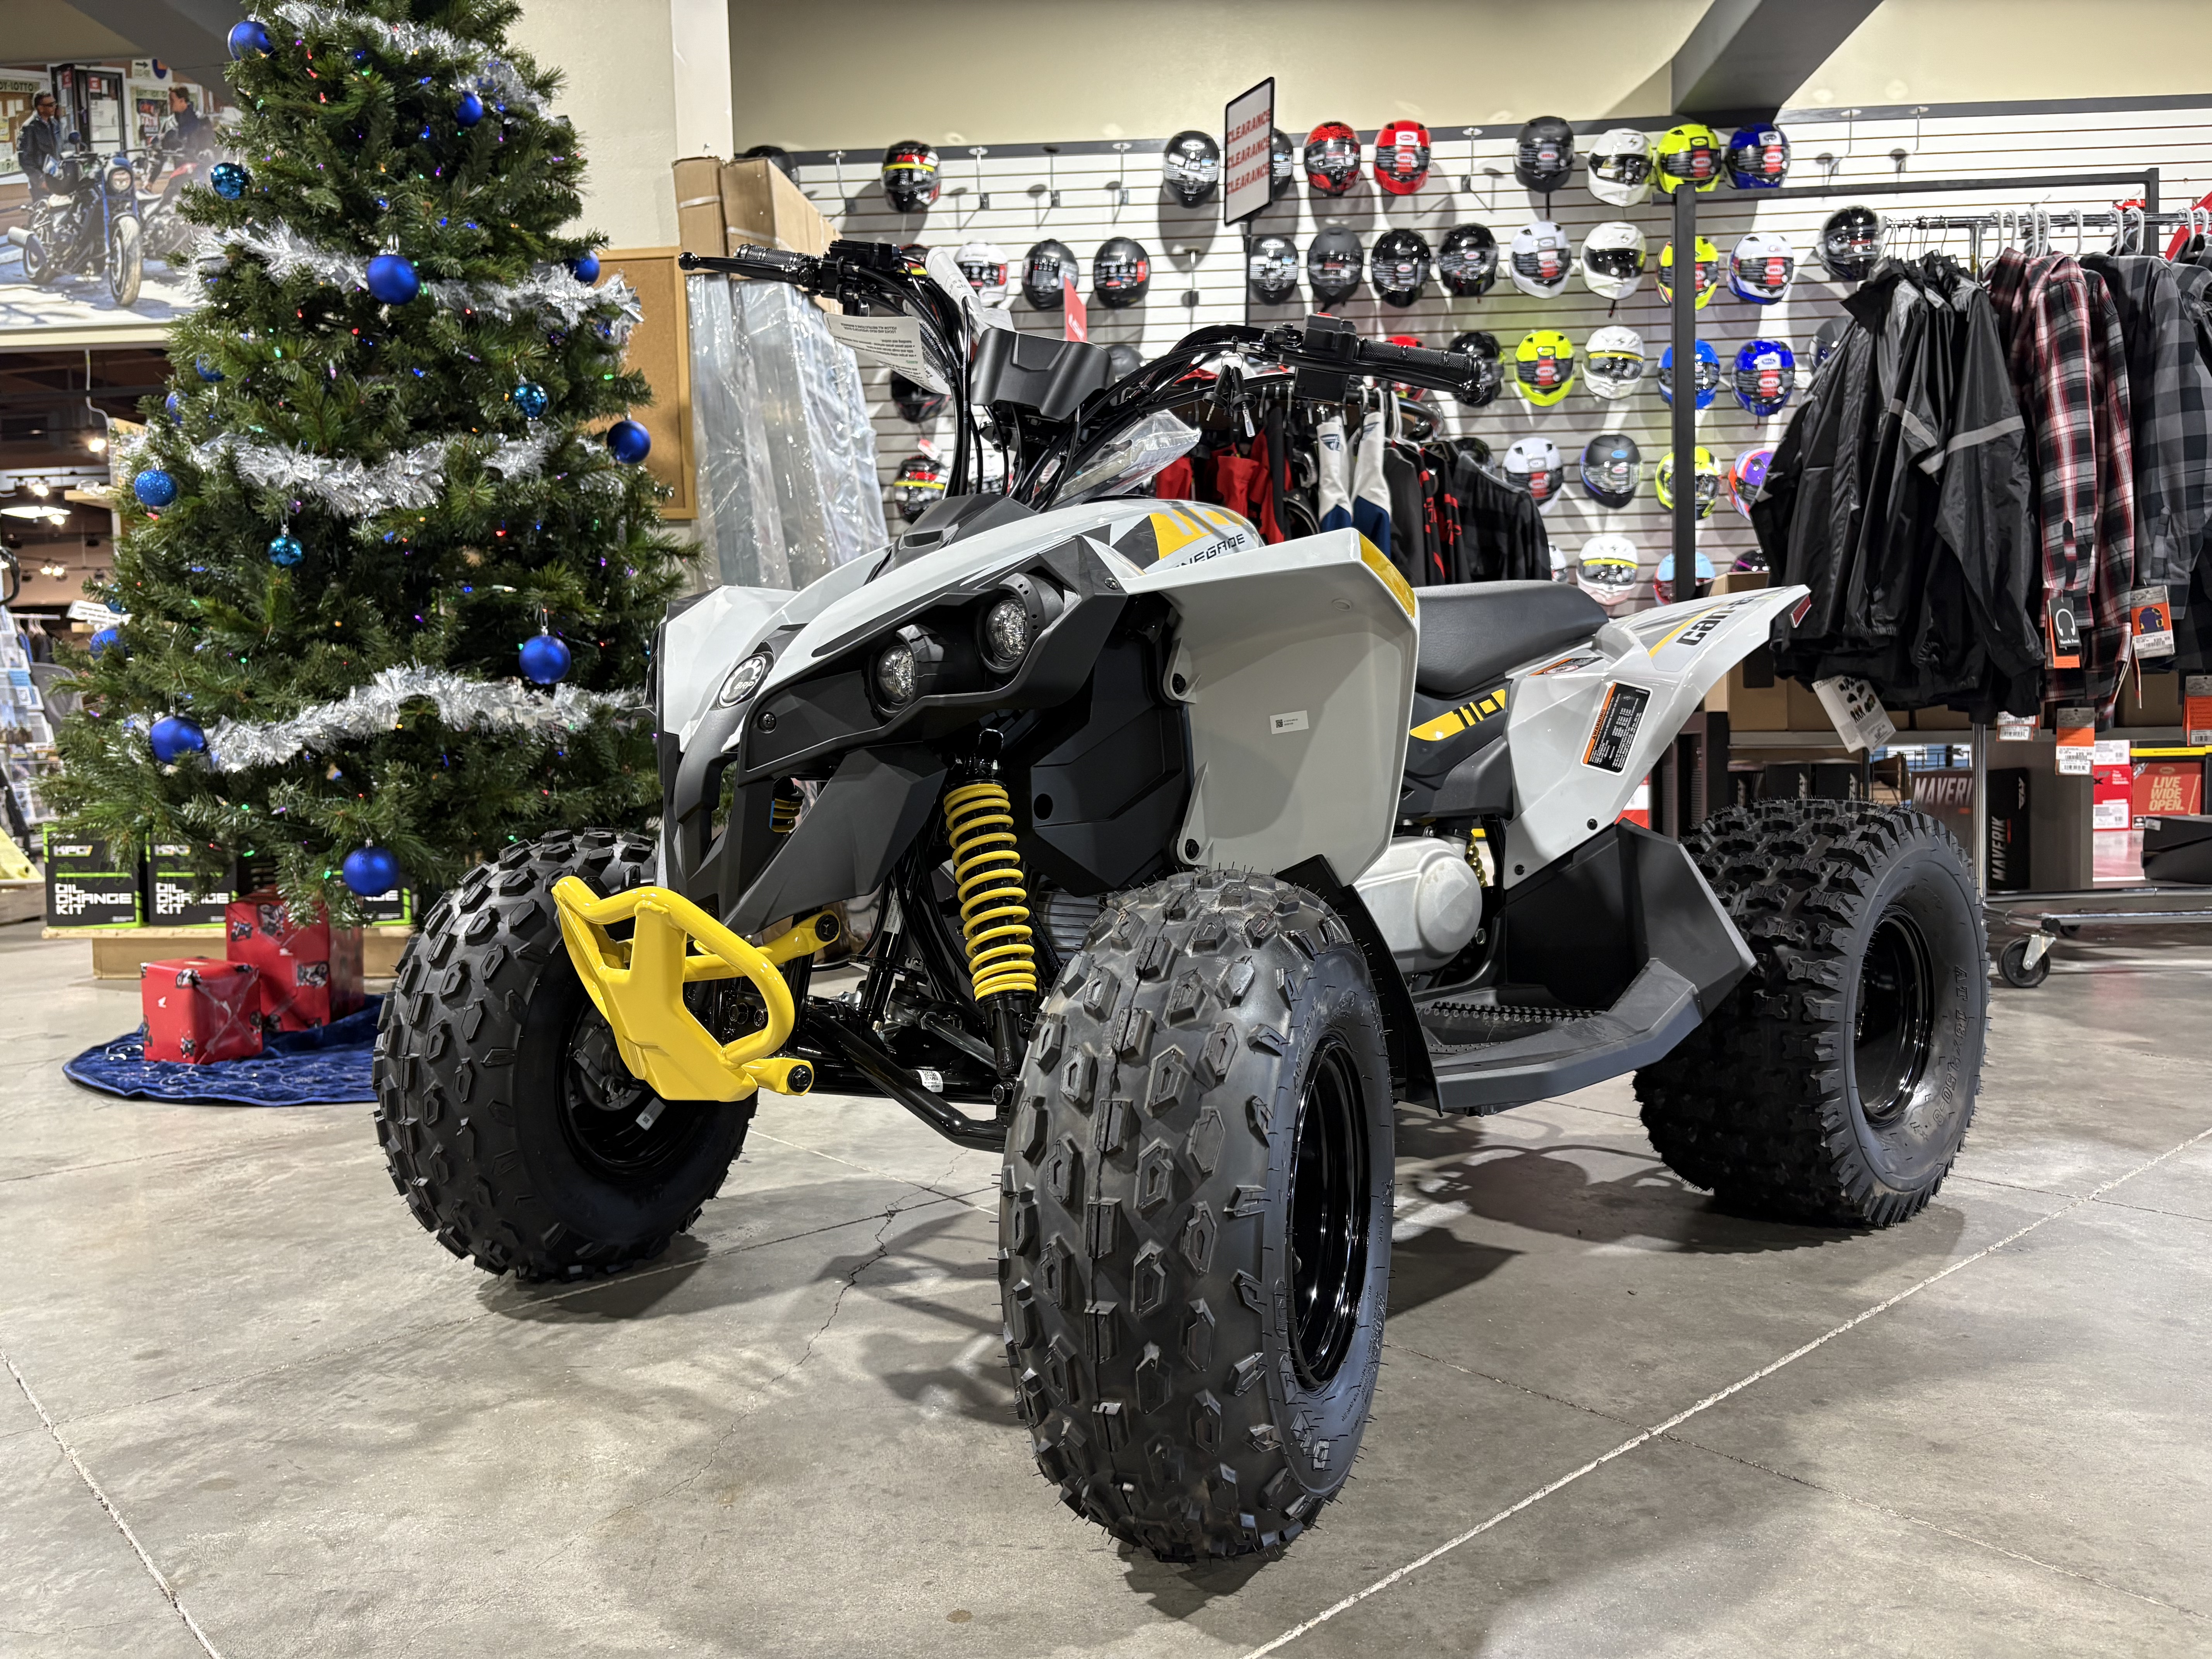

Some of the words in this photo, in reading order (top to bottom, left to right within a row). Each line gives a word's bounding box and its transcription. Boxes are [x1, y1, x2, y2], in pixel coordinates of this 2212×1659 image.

[733, 681, 755, 689] BRP
[1452, 695, 1504, 728] 110
[1592, 708, 1606, 735] WARNING
[2154, 776, 2181, 788] LIVE
[1913, 777, 1973, 805] MAVERI
[2150, 788, 2183, 800] WIDE
[2149, 800, 2185, 811] OPEN.
[1992, 816, 2007, 882] MAVERIK
[55, 883, 85, 893] OIL
[156, 883, 184, 893] OIL
[56, 893, 132, 904] CHANGE
[56, 904, 86, 915] KIT
[157, 903, 185, 914] KIT
